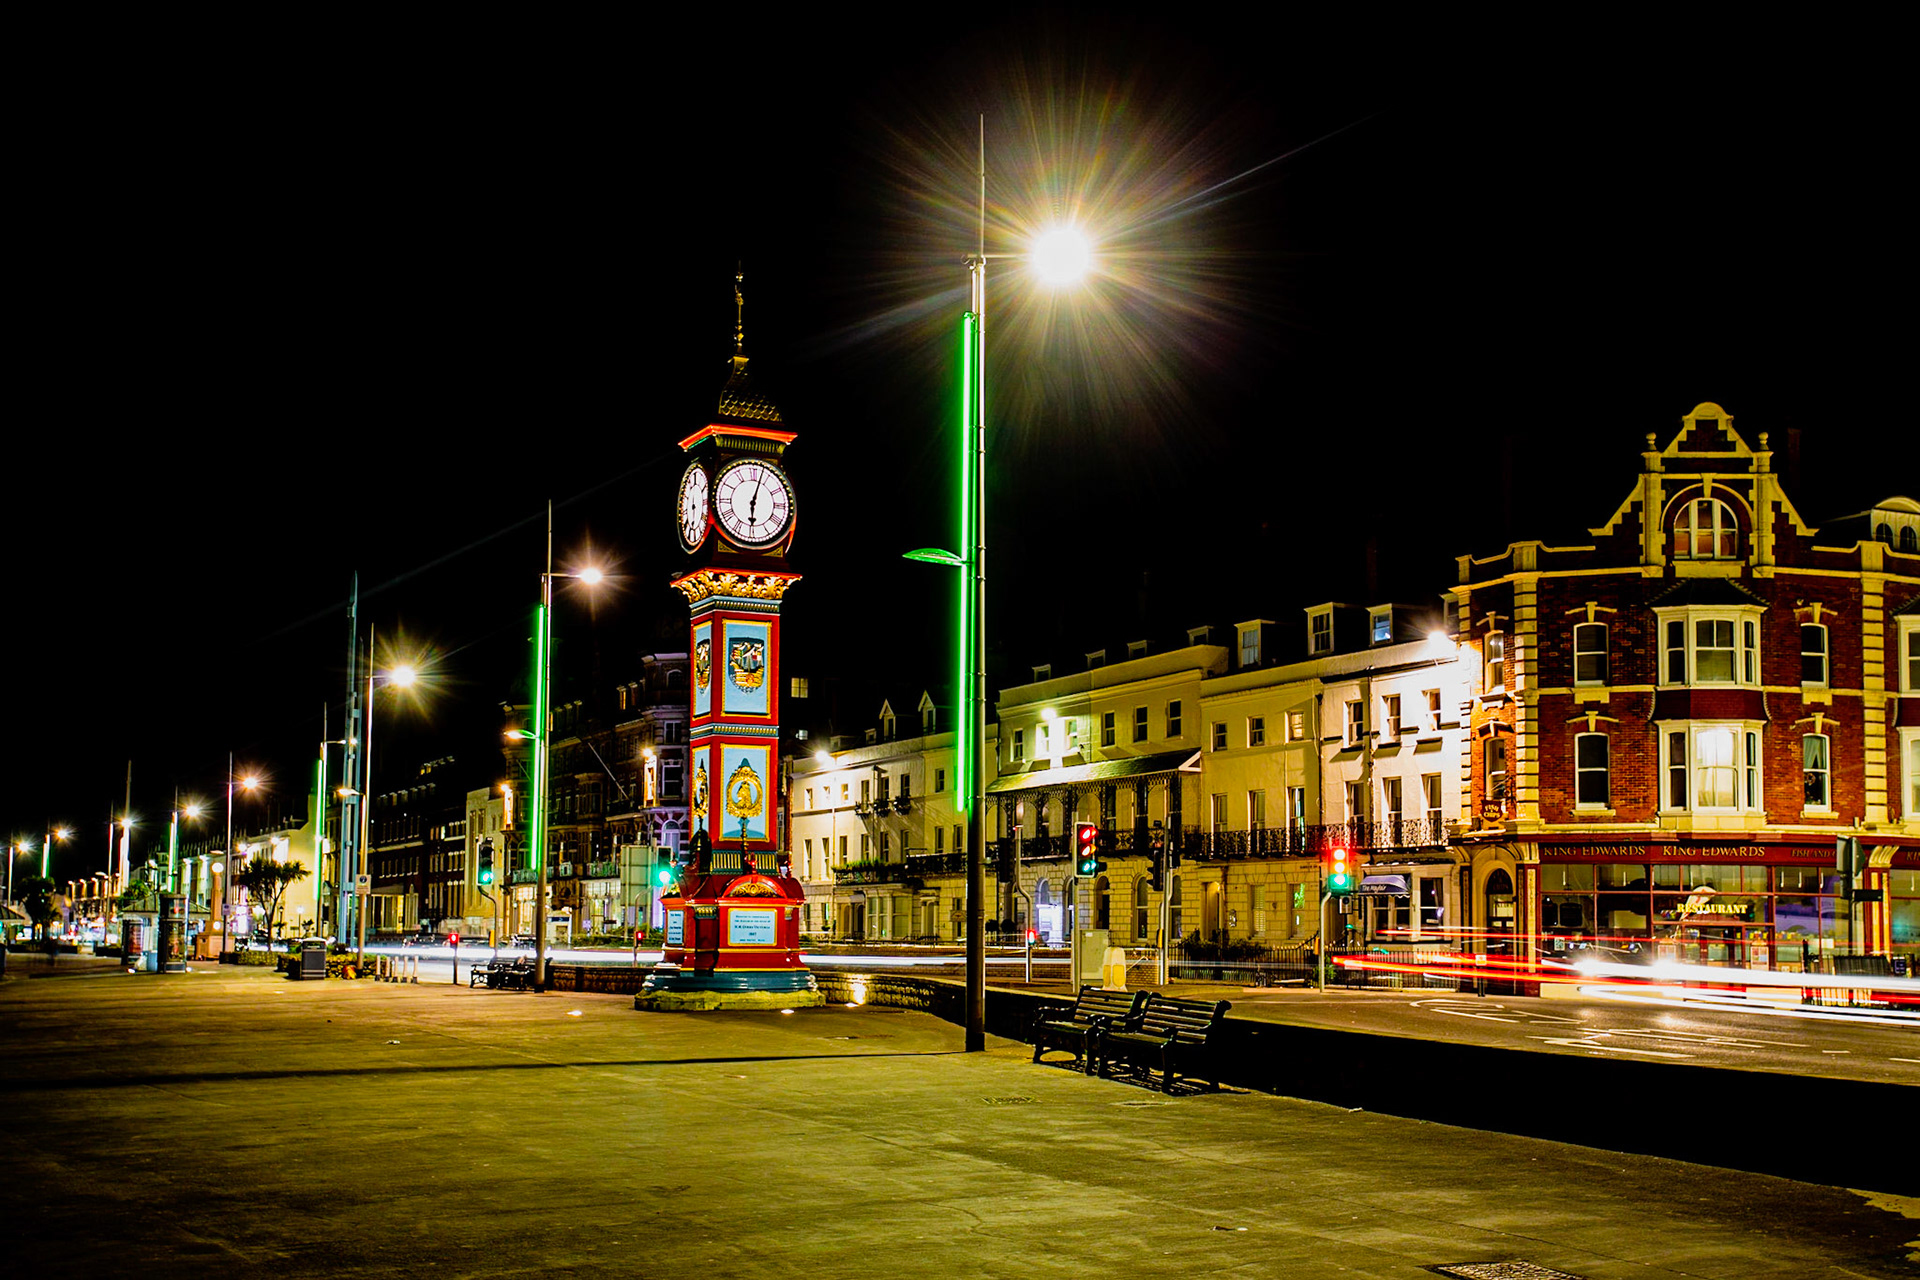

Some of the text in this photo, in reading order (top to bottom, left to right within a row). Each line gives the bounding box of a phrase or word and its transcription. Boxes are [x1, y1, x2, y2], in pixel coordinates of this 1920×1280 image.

[1544, 845, 1646, 856] KING EDWARDS
[1663, 846, 1766, 857] KING EDWARDS
[1791, 848, 1810, 857] FISH
[1813, 849, 1831, 858] AND
[1677, 903, 1748, 914] RESTAURANT
